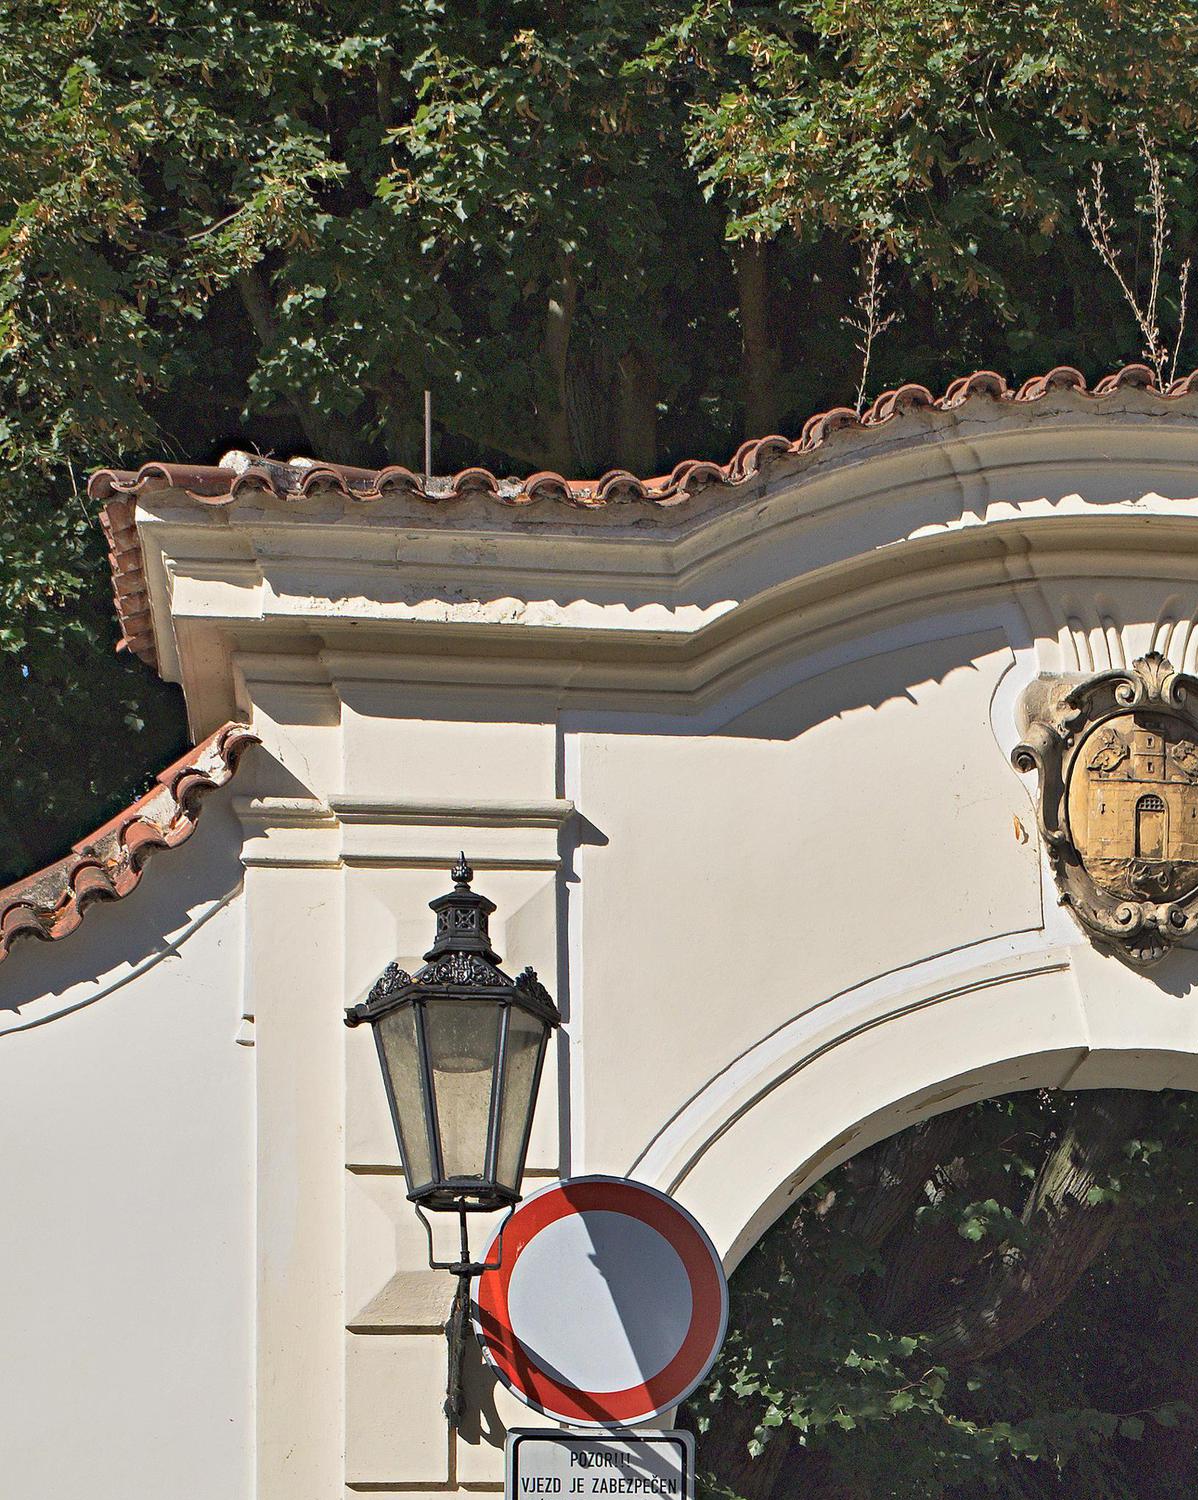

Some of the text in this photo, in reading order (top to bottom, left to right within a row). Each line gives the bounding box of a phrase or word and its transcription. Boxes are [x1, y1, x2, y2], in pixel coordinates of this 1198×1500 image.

[570, 1451, 631, 1468] POZOR!!!
[521, 1474, 677, 1495] VJEZD JE ZABEZPEČEN
